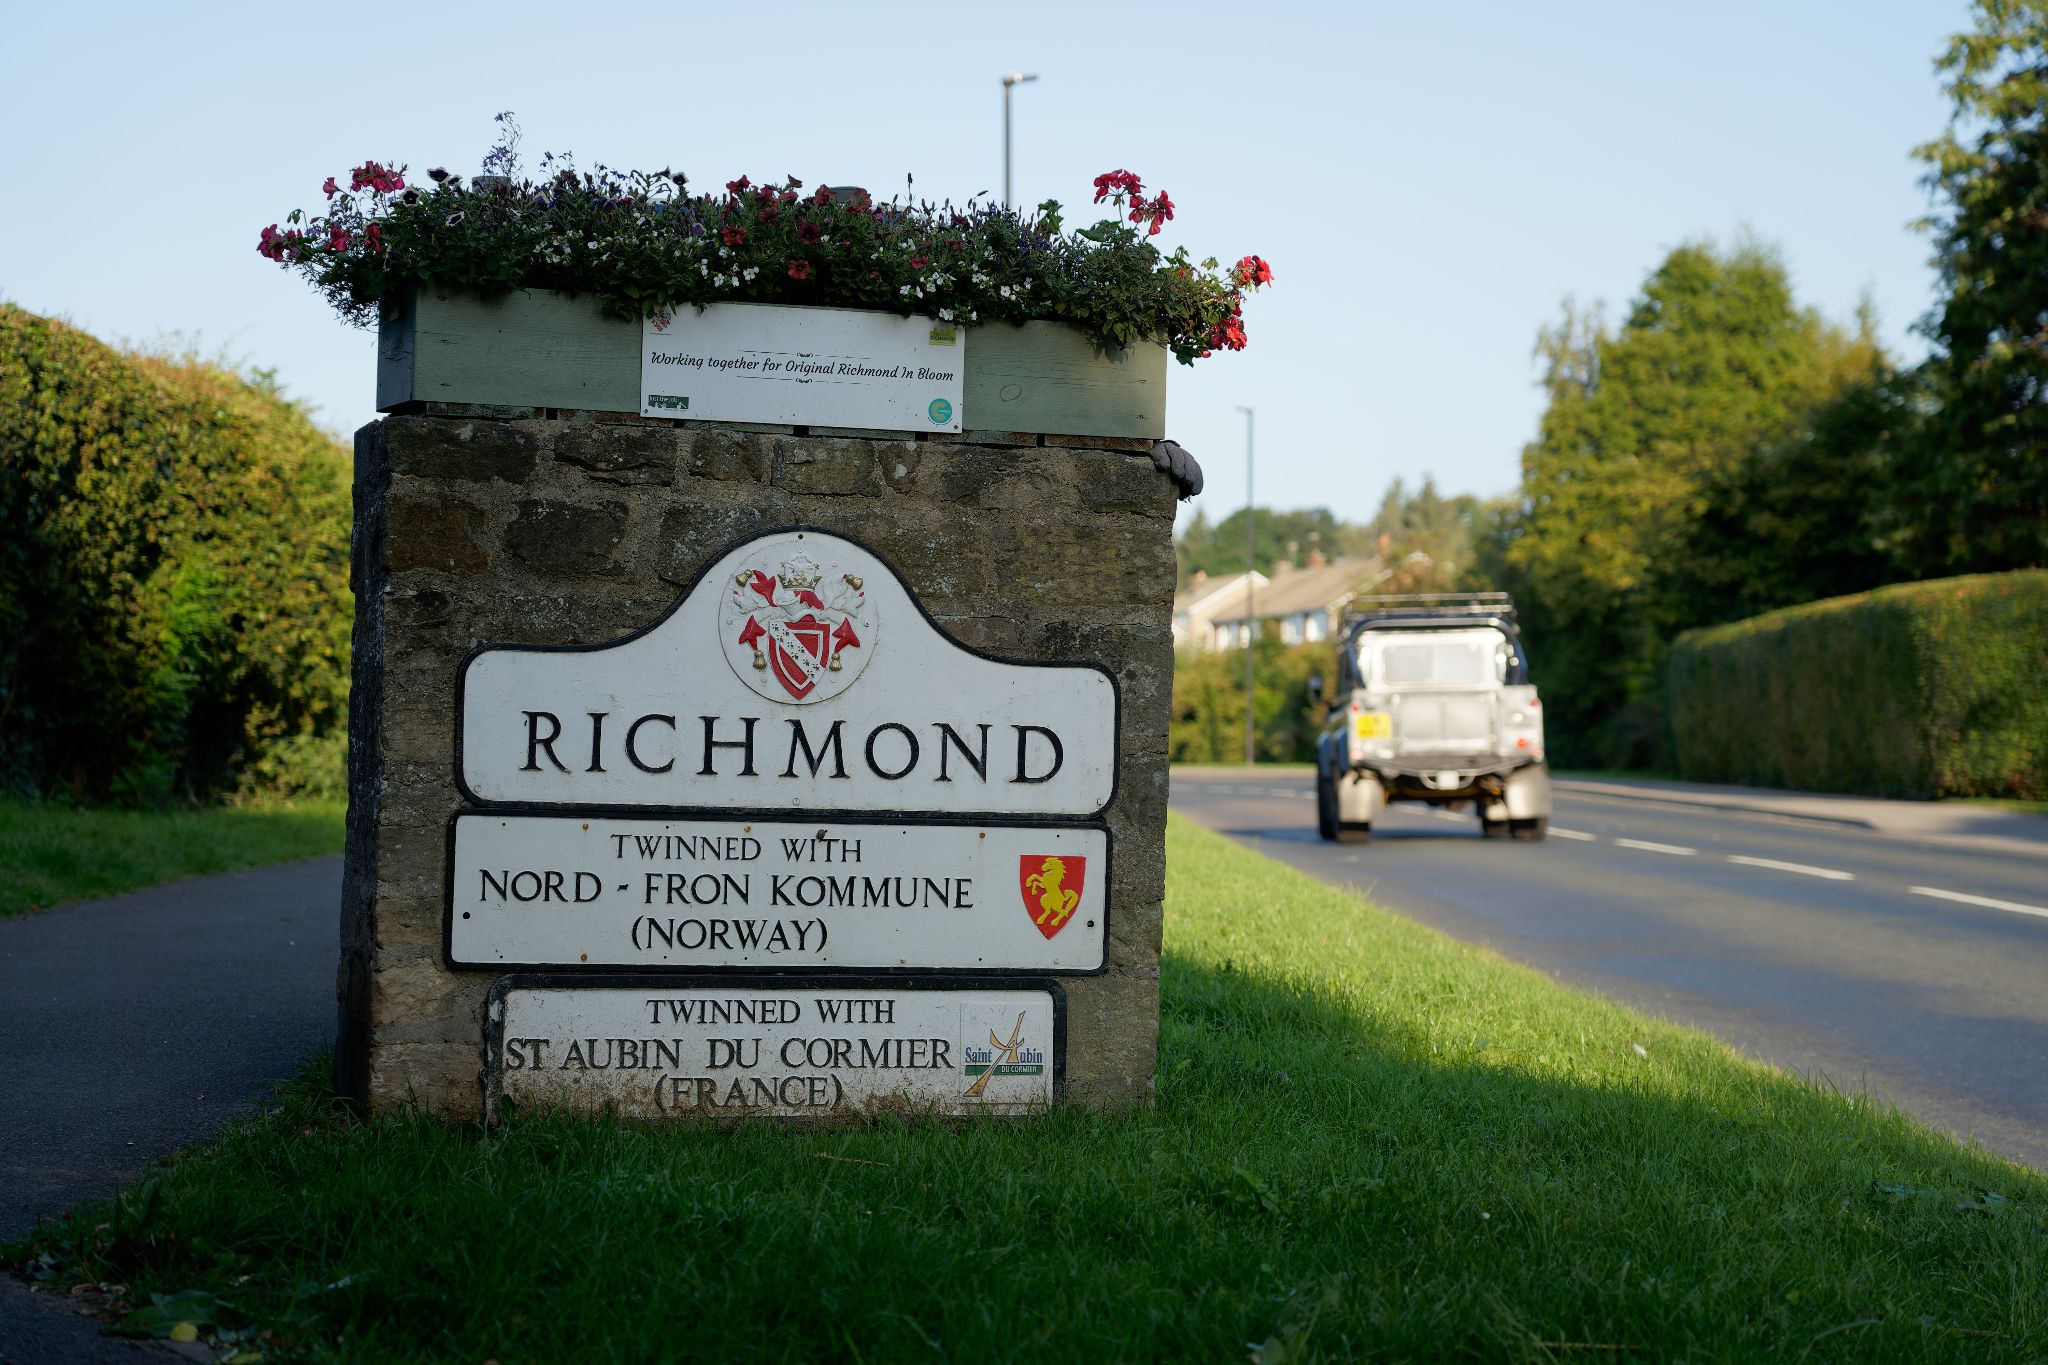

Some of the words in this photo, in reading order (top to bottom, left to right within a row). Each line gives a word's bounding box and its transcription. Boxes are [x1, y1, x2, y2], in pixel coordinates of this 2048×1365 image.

[651, 352, 703, 368] Working
[708, 357, 759, 372] together
[762, 358, 782, 373] for
[785, 360, 834, 375] Original
[837, 363, 898, 378] Richmond
[918, 368, 954, 381] Bloom
[519, 711, 1064, 784] RICHMOND
[610, 834, 762, 861] TWINNED
[781, 838, 862, 863] WITH
[479, 869, 602, 902] NORD
[644, 874, 750, 906] FRON
[771, 876, 974, 909] KOMMUNE
[631, 917, 828, 953] (NORWAY)
[646, 1000, 800, 1024] TWINNED
[815, 1000, 895, 1024] WITH
[504, 1039, 550, 1070] ST
[562, 1039, 683, 1069] AUBIN
[706, 1039, 762, 1068] DU
[781, 1039, 955, 1069] CORMIER
[965, 1047, 992, 1063] Saint
[653, 1074, 843, 1111] (FRANCE)
